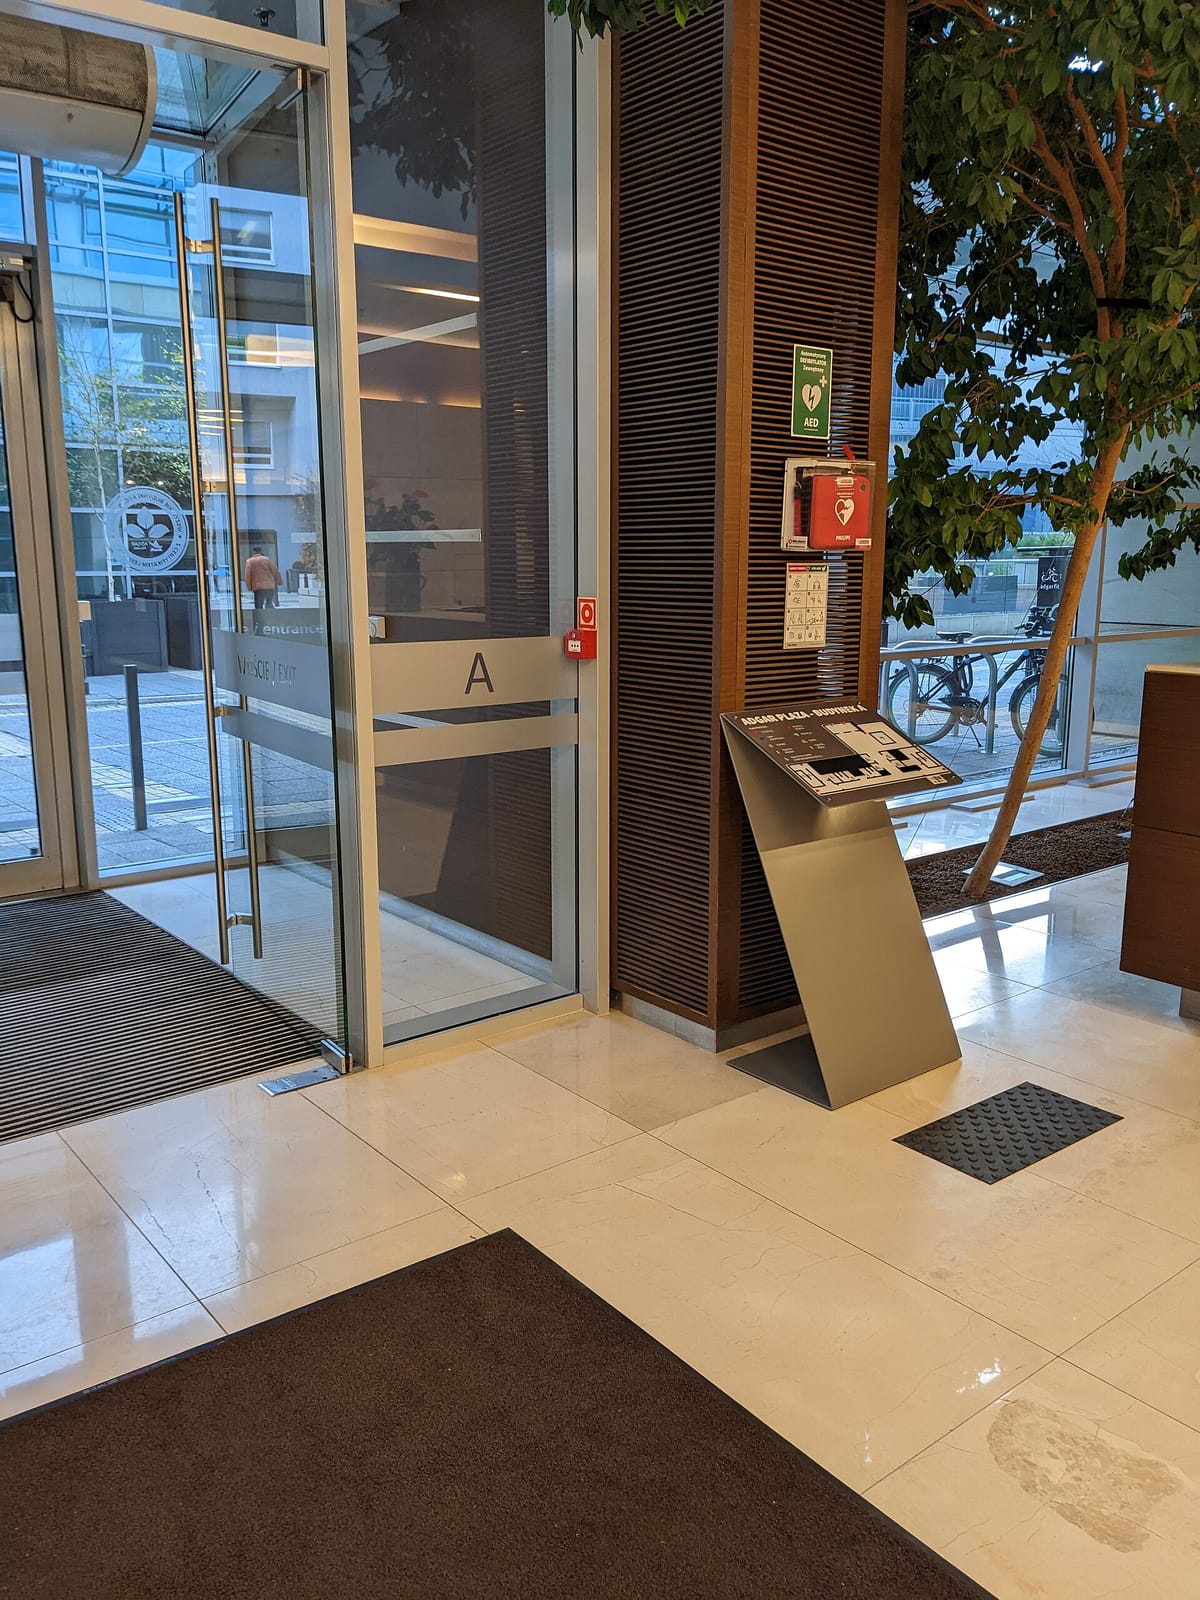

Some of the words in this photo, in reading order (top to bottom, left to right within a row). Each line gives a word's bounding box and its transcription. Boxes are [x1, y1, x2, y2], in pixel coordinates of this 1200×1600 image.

[803, 417, 819, 428] AED
[278, 664, 297, 681] EXIT
[465, 652, 494, 694] A
[741, 713, 777, 726] ADGAR
[775, 711, 810, 722] PLAZA
